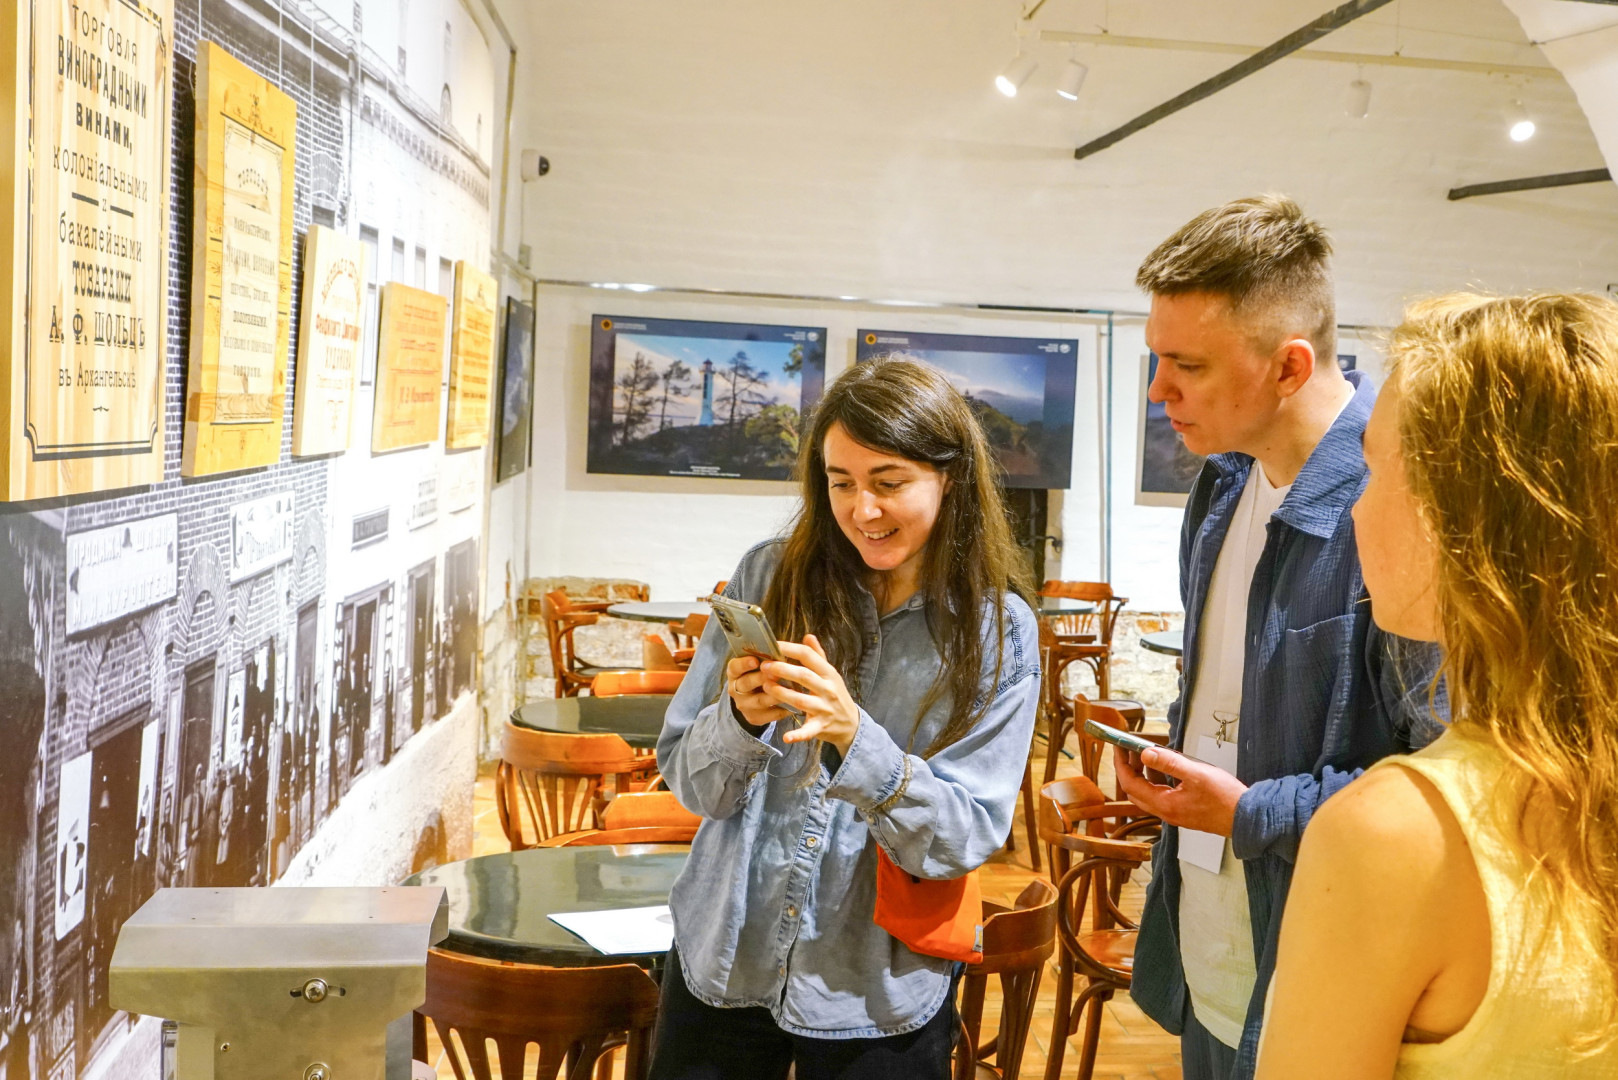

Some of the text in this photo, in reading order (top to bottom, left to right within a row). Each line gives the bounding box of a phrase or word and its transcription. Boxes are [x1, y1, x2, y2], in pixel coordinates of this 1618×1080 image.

[72, 4, 137, 66] ТОРГОВЛЯ
[58, 34, 147, 119] ВИНОГРАДНЫМИ
[76, 102, 133, 156] ВИНАМИ,
[59, 211, 142, 262] бакалейными
[72, 260, 131, 304] ТОВАРАМИ
[49, 306, 145, 353] А. Ф. ШОЛЬЦЪ
[58, 367, 72, 387] въ
